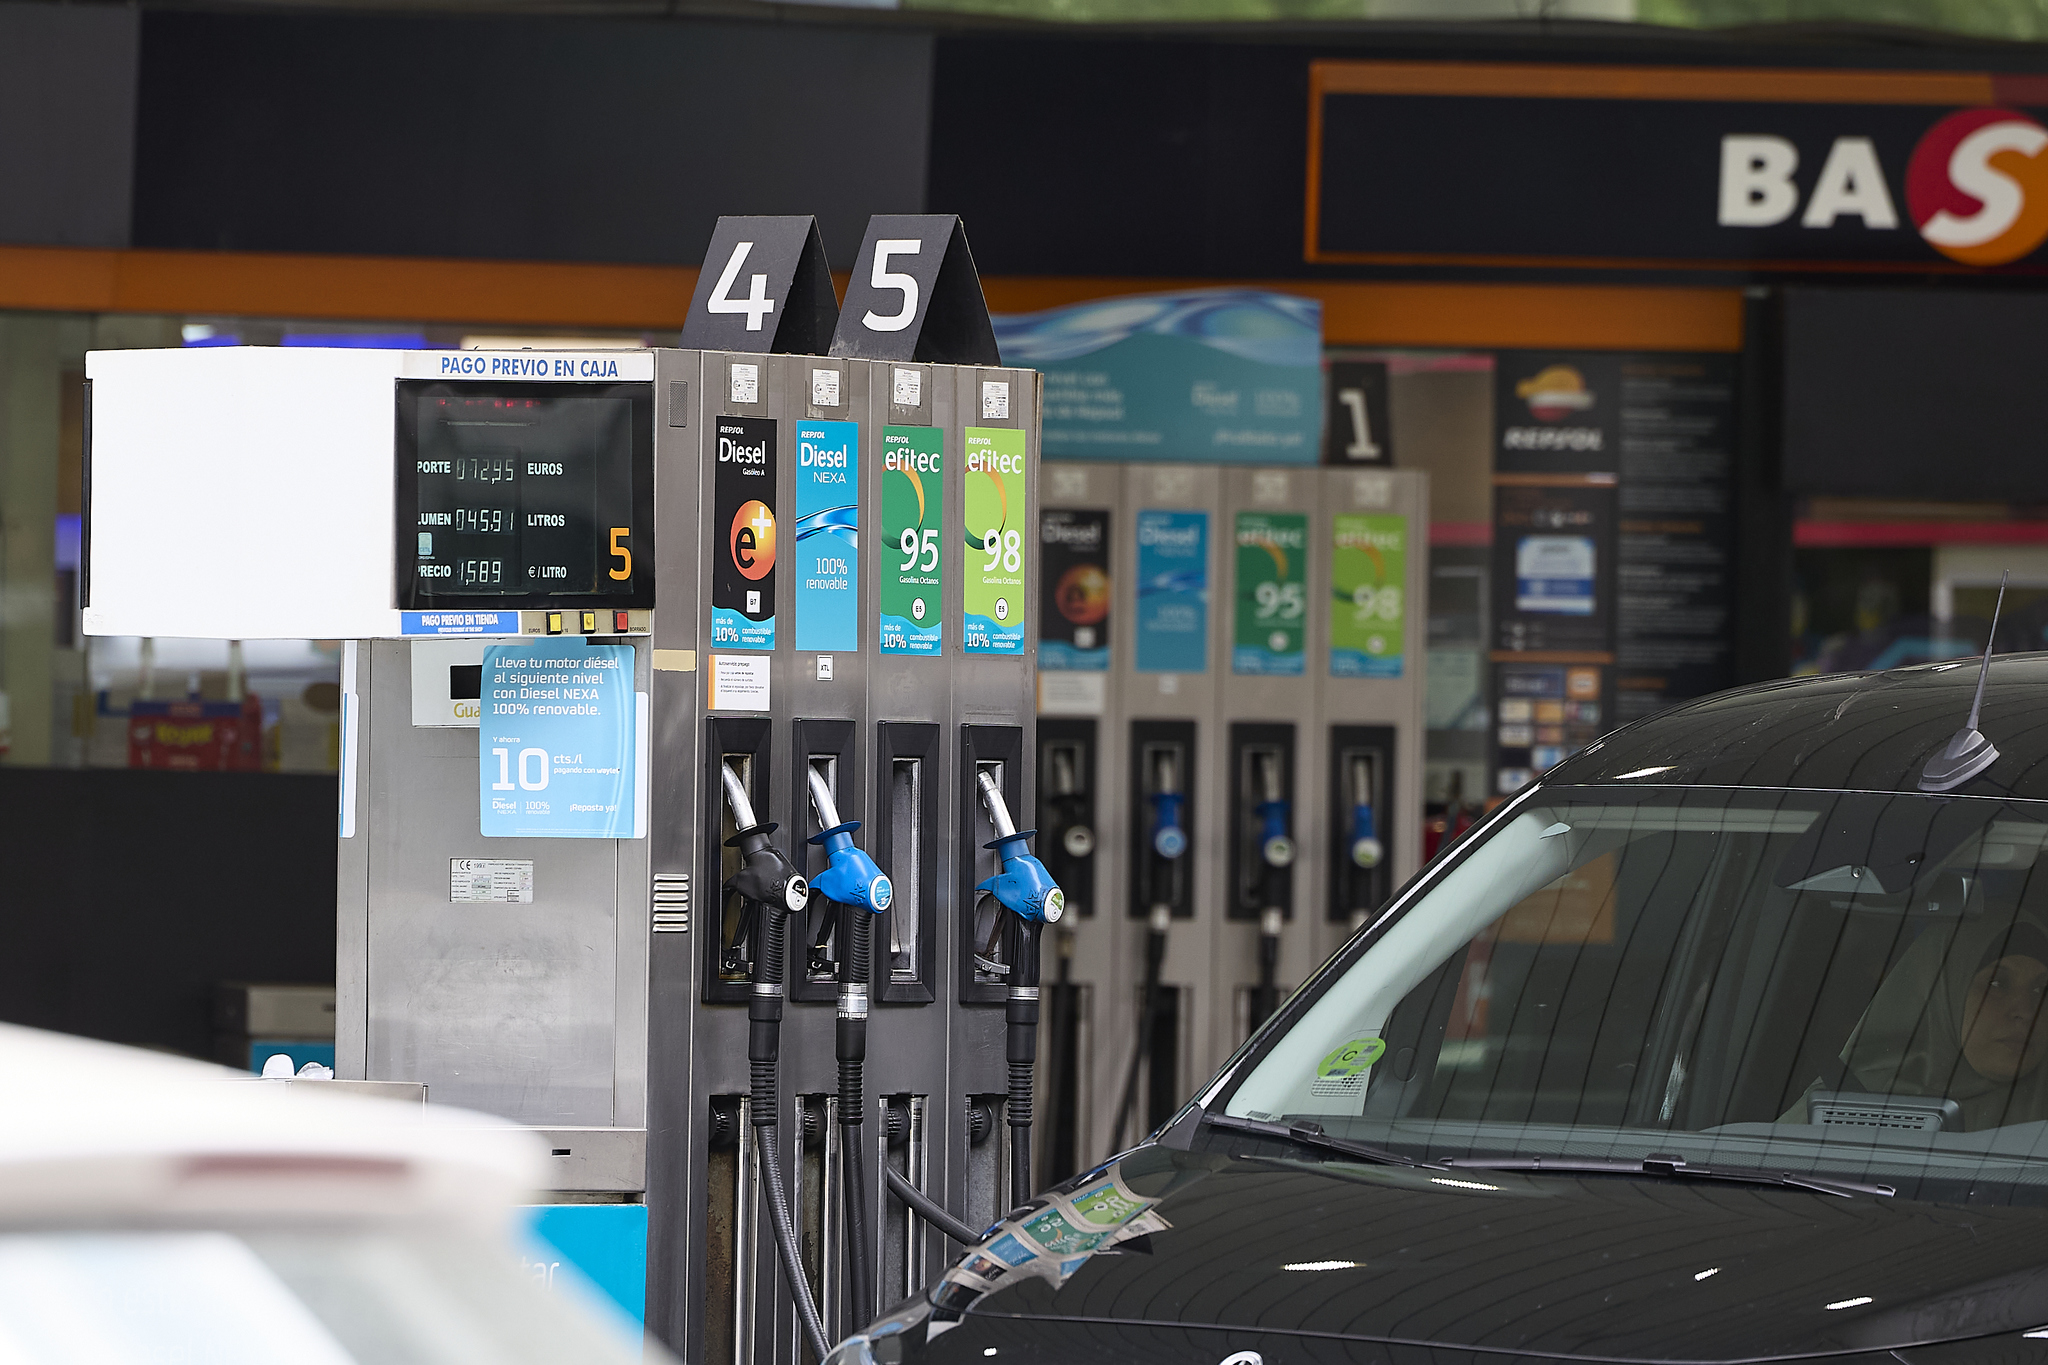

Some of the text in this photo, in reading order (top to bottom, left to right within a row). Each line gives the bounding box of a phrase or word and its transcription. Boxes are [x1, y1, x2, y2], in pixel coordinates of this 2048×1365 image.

[707, 241, 775, 331] 4
[861, 239, 922, 332] 5
[442, 357, 618, 377] PAGO PREVIO EN CAJA
[720, 426, 744, 434] REPSOL
[1339, 388, 1380, 459] 1
[801, 431, 825, 439] REPSOL
[885, 436, 910, 444] REPSOL
[968, 437, 991, 445] REPSOL
[719, 437, 766, 464] Diesel
[800, 442, 847, 468] Diesel
[885, 448, 940, 473] efitec
[968, 449, 1022, 474] efitec
[527, 463, 563, 475] EUROS
[813, 472, 847, 484] NEXA
[527, 514, 565, 527] LITROS
[609, 527, 632, 581] 5
[900, 528, 939, 572] 95
[983, 529, 1021, 573] 98
[816, 558, 848, 575] 100%
[806, 577, 848, 591] renovable
[899, 576, 939, 585] Gasolina Octanos
[982, 576, 1021, 585] Gasolina Octanos
[1255, 581, 1303, 620] 95
[1353, 584, 1402, 622] 98
[421, 614, 498, 626] PAGO PREVIO EN TIENDA
[716, 617, 726, 625] más
[968, 622, 977, 630] más
[884, 623, 894, 631] más
[715, 627, 739, 642] 10%
[883, 634, 906, 648] 10%
[967, 633, 990, 647] 10%
[910, 642, 933, 650] renovable
[495, 656, 619, 669] Lleva tu motor diésel
[494, 672, 604, 686] al siguiente nivel
[493, 688, 599, 700] con Diesel NEXA
[493, 703, 601, 716] 100% renovable.
[554, 754, 583, 764] cts./l
[492, 748, 549, 791] 10
[554, 767, 582, 775] pagando
[492, 801, 516, 809] Diesel
[525, 801, 550, 810] 100%
[570, 804, 617, 814] ¡Reposta ya!
